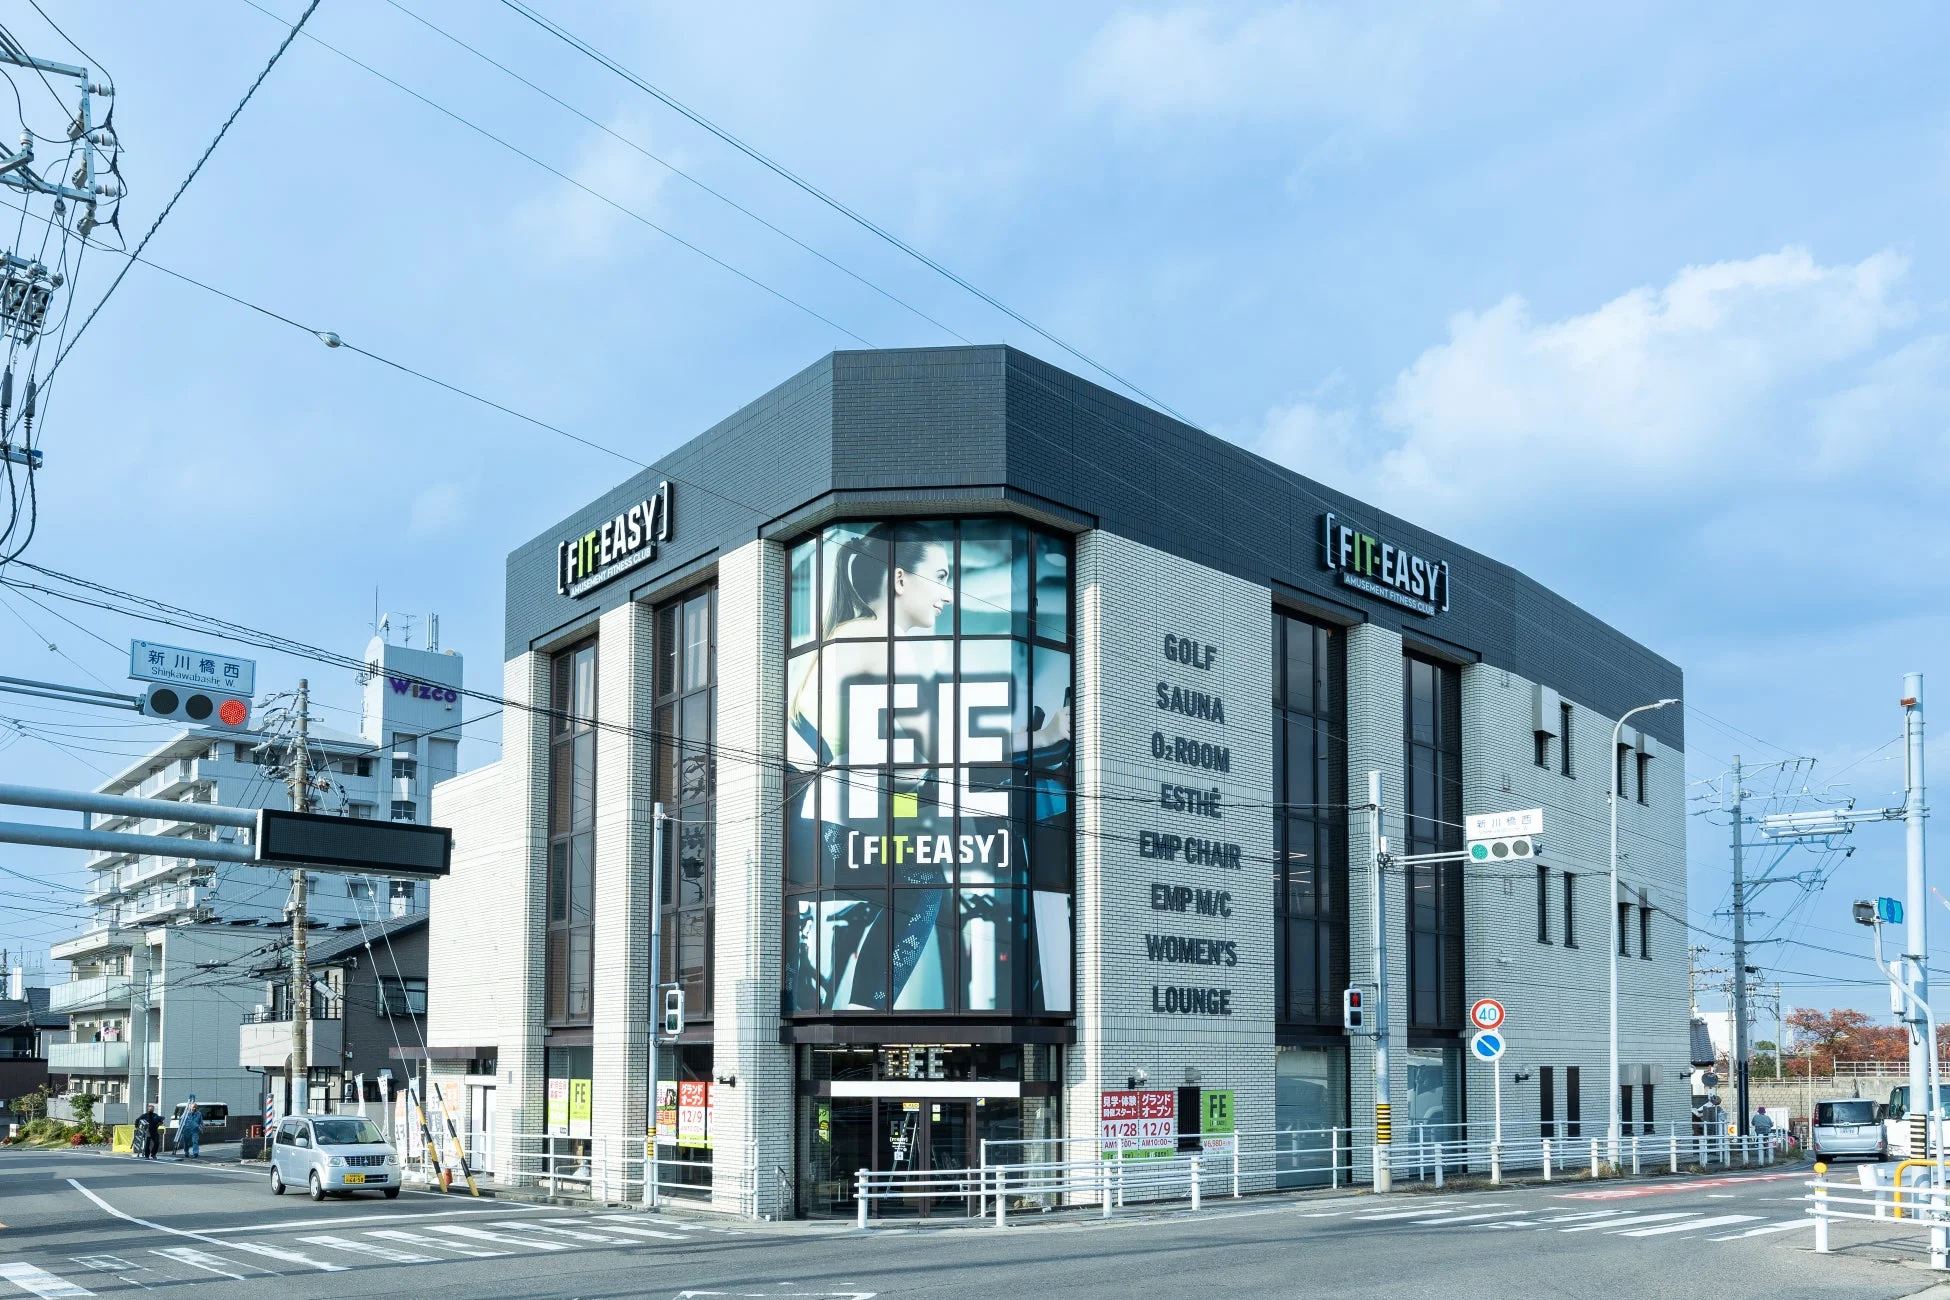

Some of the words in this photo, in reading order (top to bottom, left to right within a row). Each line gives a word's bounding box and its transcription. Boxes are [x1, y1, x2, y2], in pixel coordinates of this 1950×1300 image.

[570, 571, 607, 597] AMUSEMENT
[608, 558, 633, 579] FITNESS
[634, 547, 652, 565] CLUB
[1345, 575, 1388, 598] AMUSEMENT
[1389, 591, 1416, 609] FITNESS
[1417, 602, 1435, 615] CLUB
[1164, 633, 1217, 671] GOLF
[148, 650, 240, 678] 新川橋西
[151, 666, 221, 687] Shinkawabashi
[1156, 682, 1224, 724] SAUNA
[1477, 815, 1532, 829] 新川橋西
[1139, 830, 1182, 861] EMP
[1185, 837, 1241, 870] CHAIR
[1151, 883, 1194, 912] EMP
[1196, 888, 1232, 918] M/C
[1146, 934, 1238, 967] WOMEN'S
[1152, 986, 1232, 1015] LOUNGE
[1479, 1007, 1497, 1021] 40
[681, 1083, 703, 1095] グランド
[1141, 1093, 1171, 1106] グランド
[681, 1095, 704, 1106] オープン
[682, 1110, 703, 1123] 12/9
[1141, 1105, 1172, 1118] オープン
[1103, 1122, 1137, 1137] 11/28
[1142, 1121, 1171, 1136] 12/9
